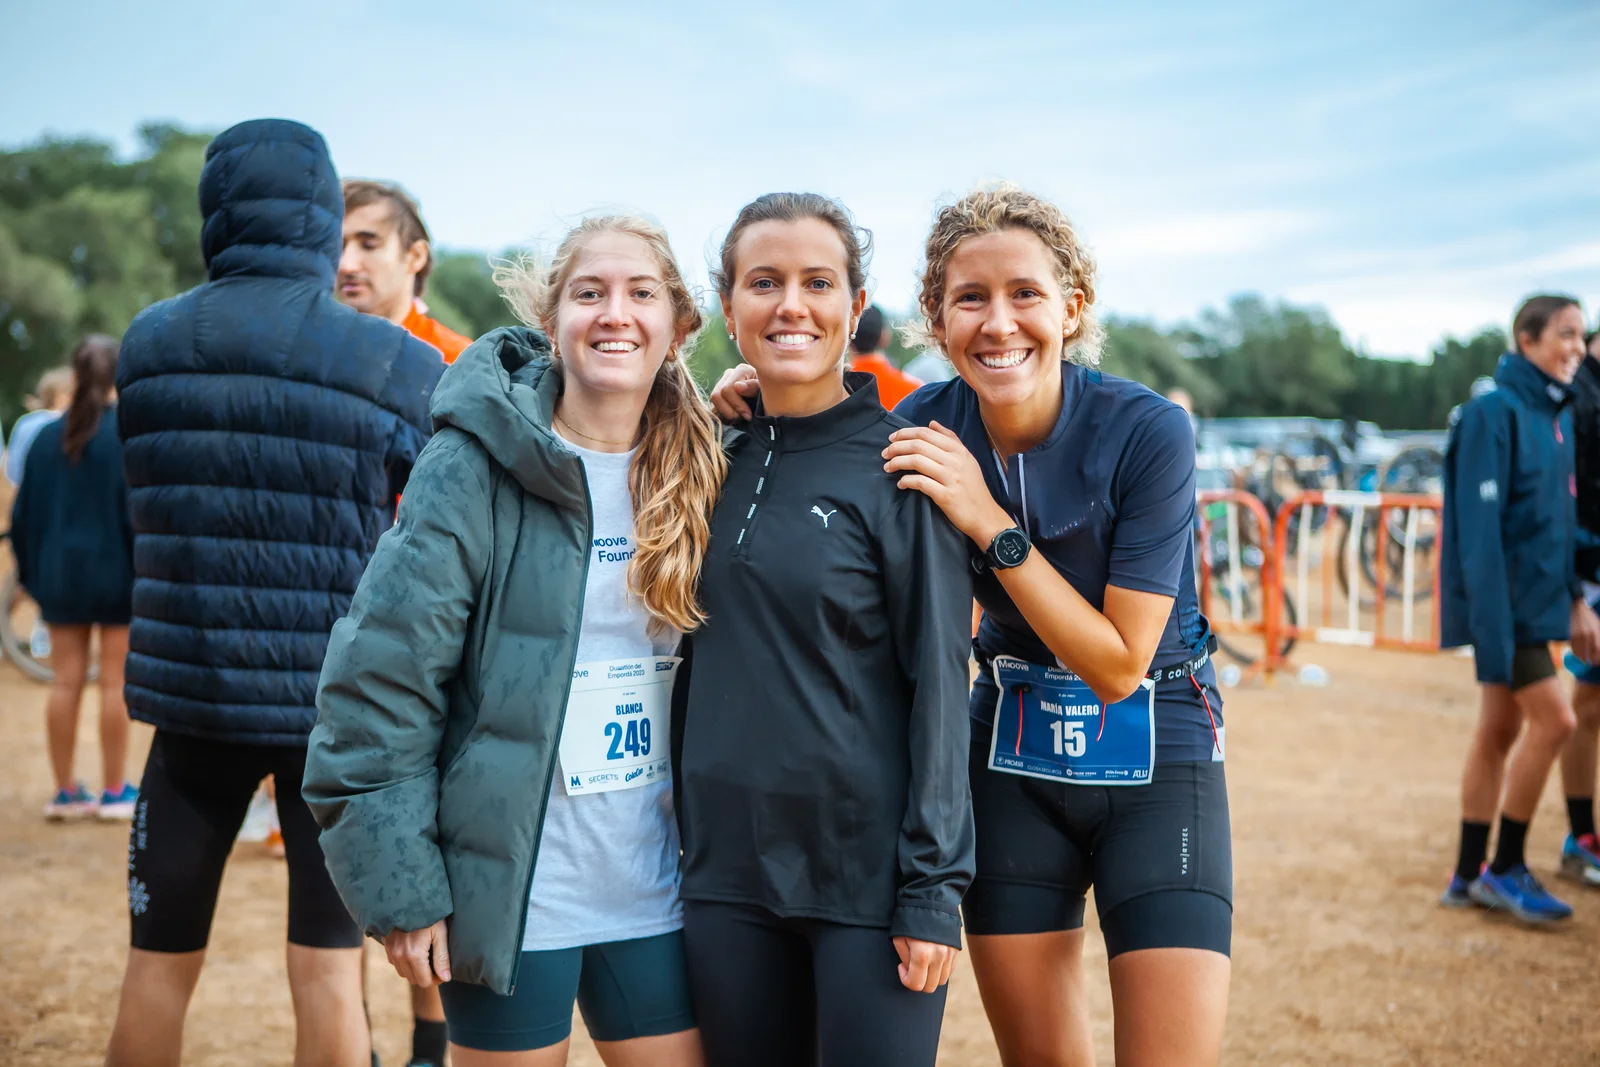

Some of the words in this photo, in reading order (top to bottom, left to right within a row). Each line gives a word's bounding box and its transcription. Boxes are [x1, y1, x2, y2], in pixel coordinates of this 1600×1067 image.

[616, 702, 643, 715] BLANCA
[1041, 700, 1063, 716] MARÍA
[1065, 704, 1099, 716] VALERO
[604, 718, 651, 760] 249
[1050, 720, 1086, 757] 15
[589, 774, 619, 784] SECRETS
